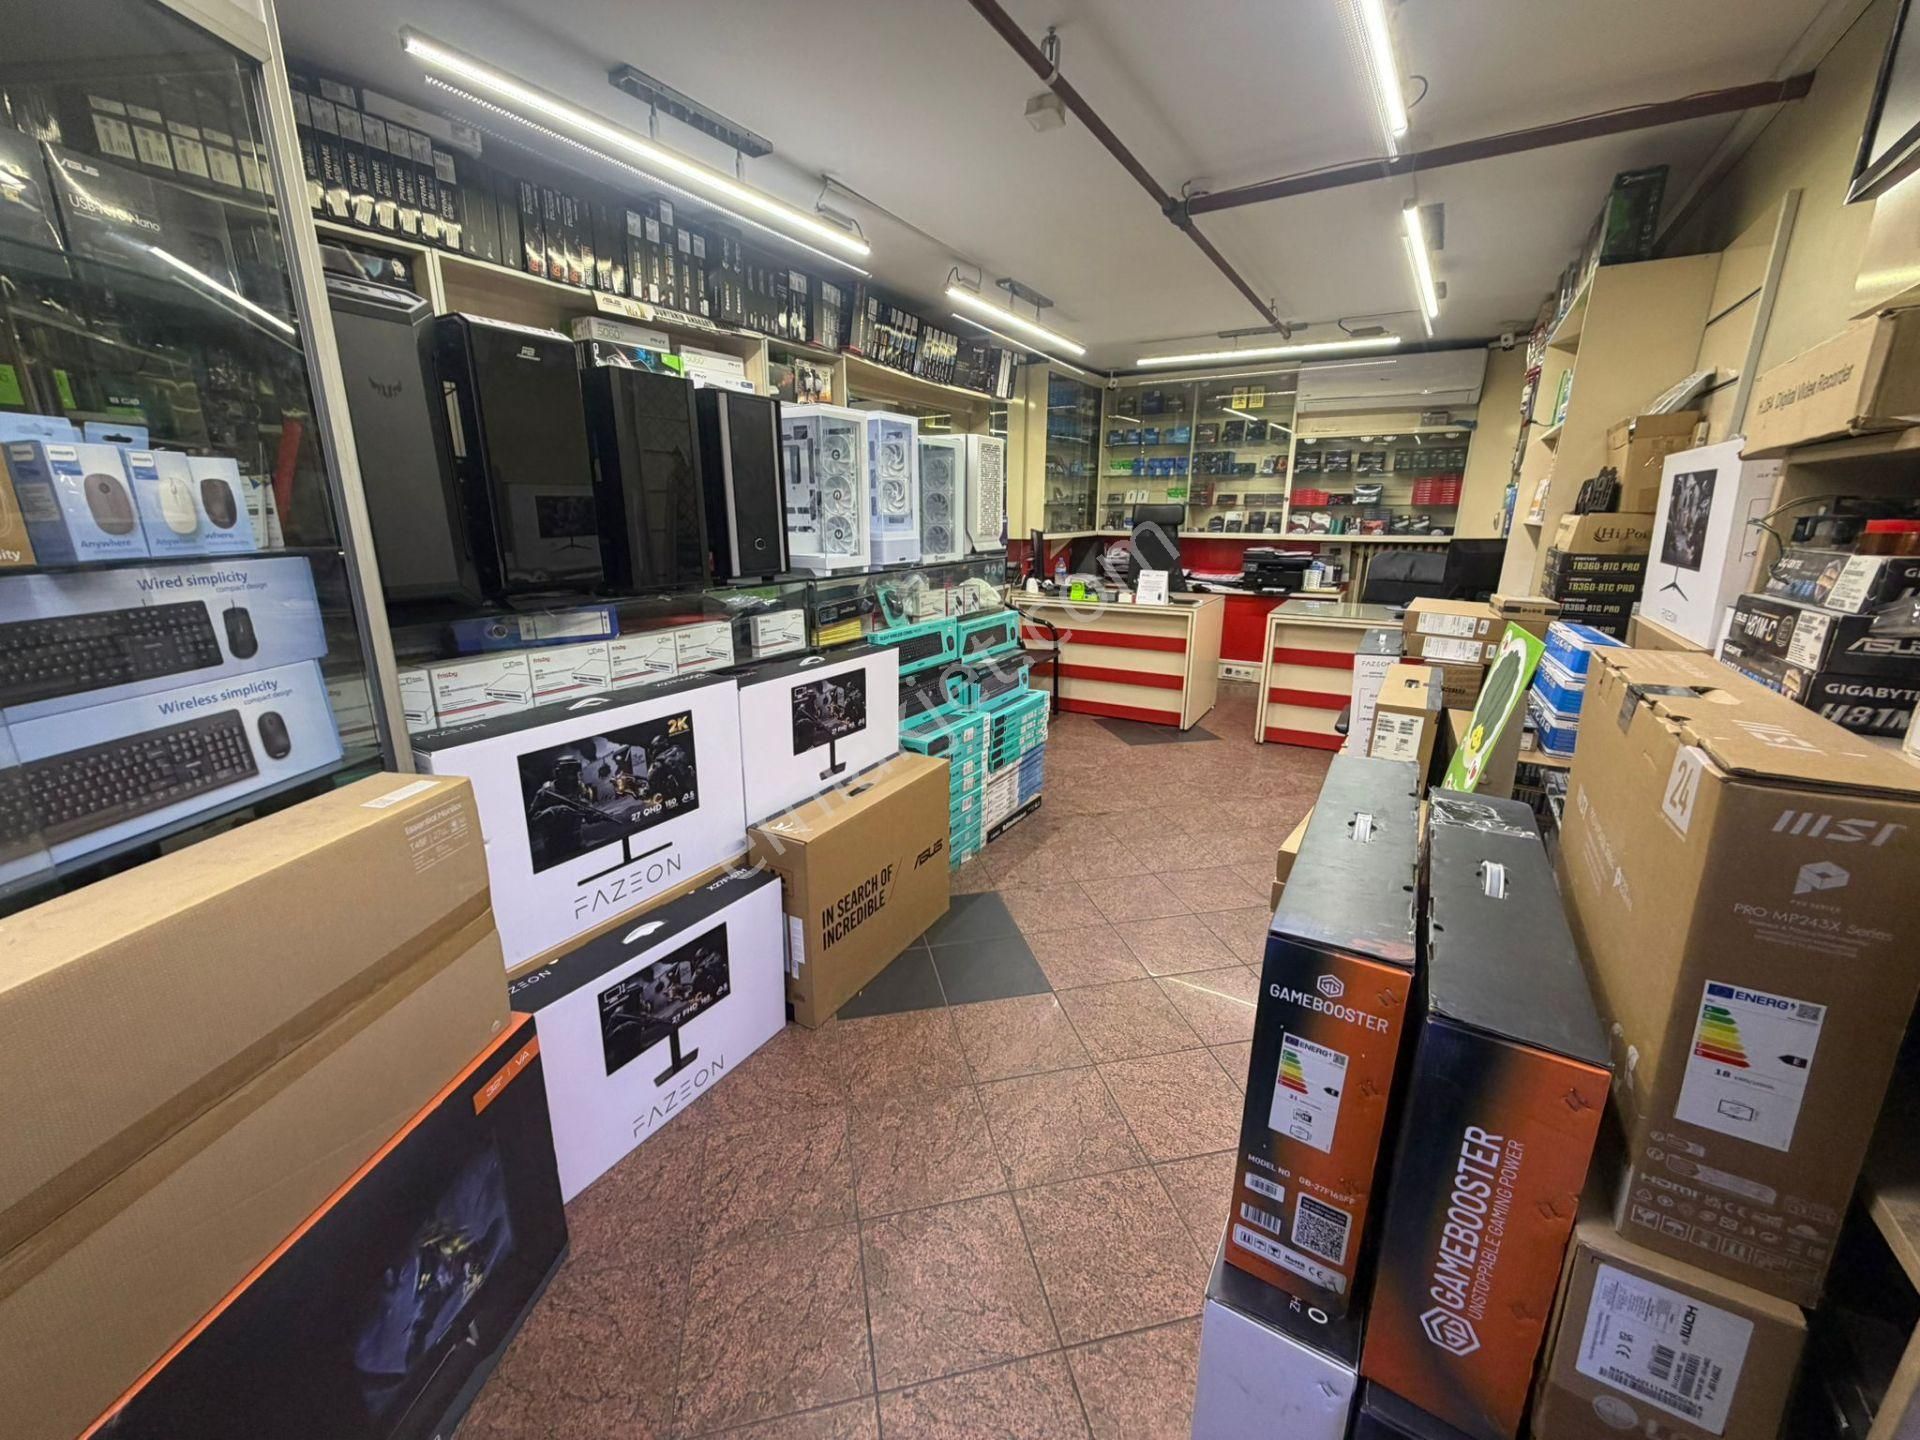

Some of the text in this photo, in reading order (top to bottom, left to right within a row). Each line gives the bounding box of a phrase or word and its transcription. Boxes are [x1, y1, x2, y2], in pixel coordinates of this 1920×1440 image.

[372, 160, 384, 194] PRIME
[419, 174, 429, 207] PRIME
[81, 538, 131, 549] Anywhere
[137, 571, 249, 591] Wired simplicity
[1621, 562, 1640, 572] PRO
[1616, 583, 1635, 593] PRO
[1603, 604, 1620, 614] PRO
[159, 679, 278, 715] Wireless simplicity
[667, 716, 690, 734] 2K
[1669, 759, 1694, 818] 24
[631, 811, 641, 822] 27
[913, 838, 943, 871] ASUS
[574, 853, 682, 919] FAZEON
[822, 863, 894, 931] IN SEARCH OF
[823, 889, 886, 952] INCREDIBLE
[1734, 902, 1767, 917] PRO
[1847, 923, 1894, 942] Series
[511, 969, 552, 994] ZEON
[1269, 983, 1389, 1034] GAMEBOOSTER
[1735, 991, 1789, 1010] ENERG
[1300, 1042, 1328, 1058] ENERG
[632, 1054, 725, 1139] FAZEON
[1247, 1153, 1277, 1172] MODEL
[1641, 1172, 1698, 1198] HDMI
[1430, 1125, 1504, 1311] GAMEBOOSTER
[1468, 1139, 1525, 1321] UNSTOPPABLE GAMING POWER
[1679, 1304, 1698, 1339] HDMI
